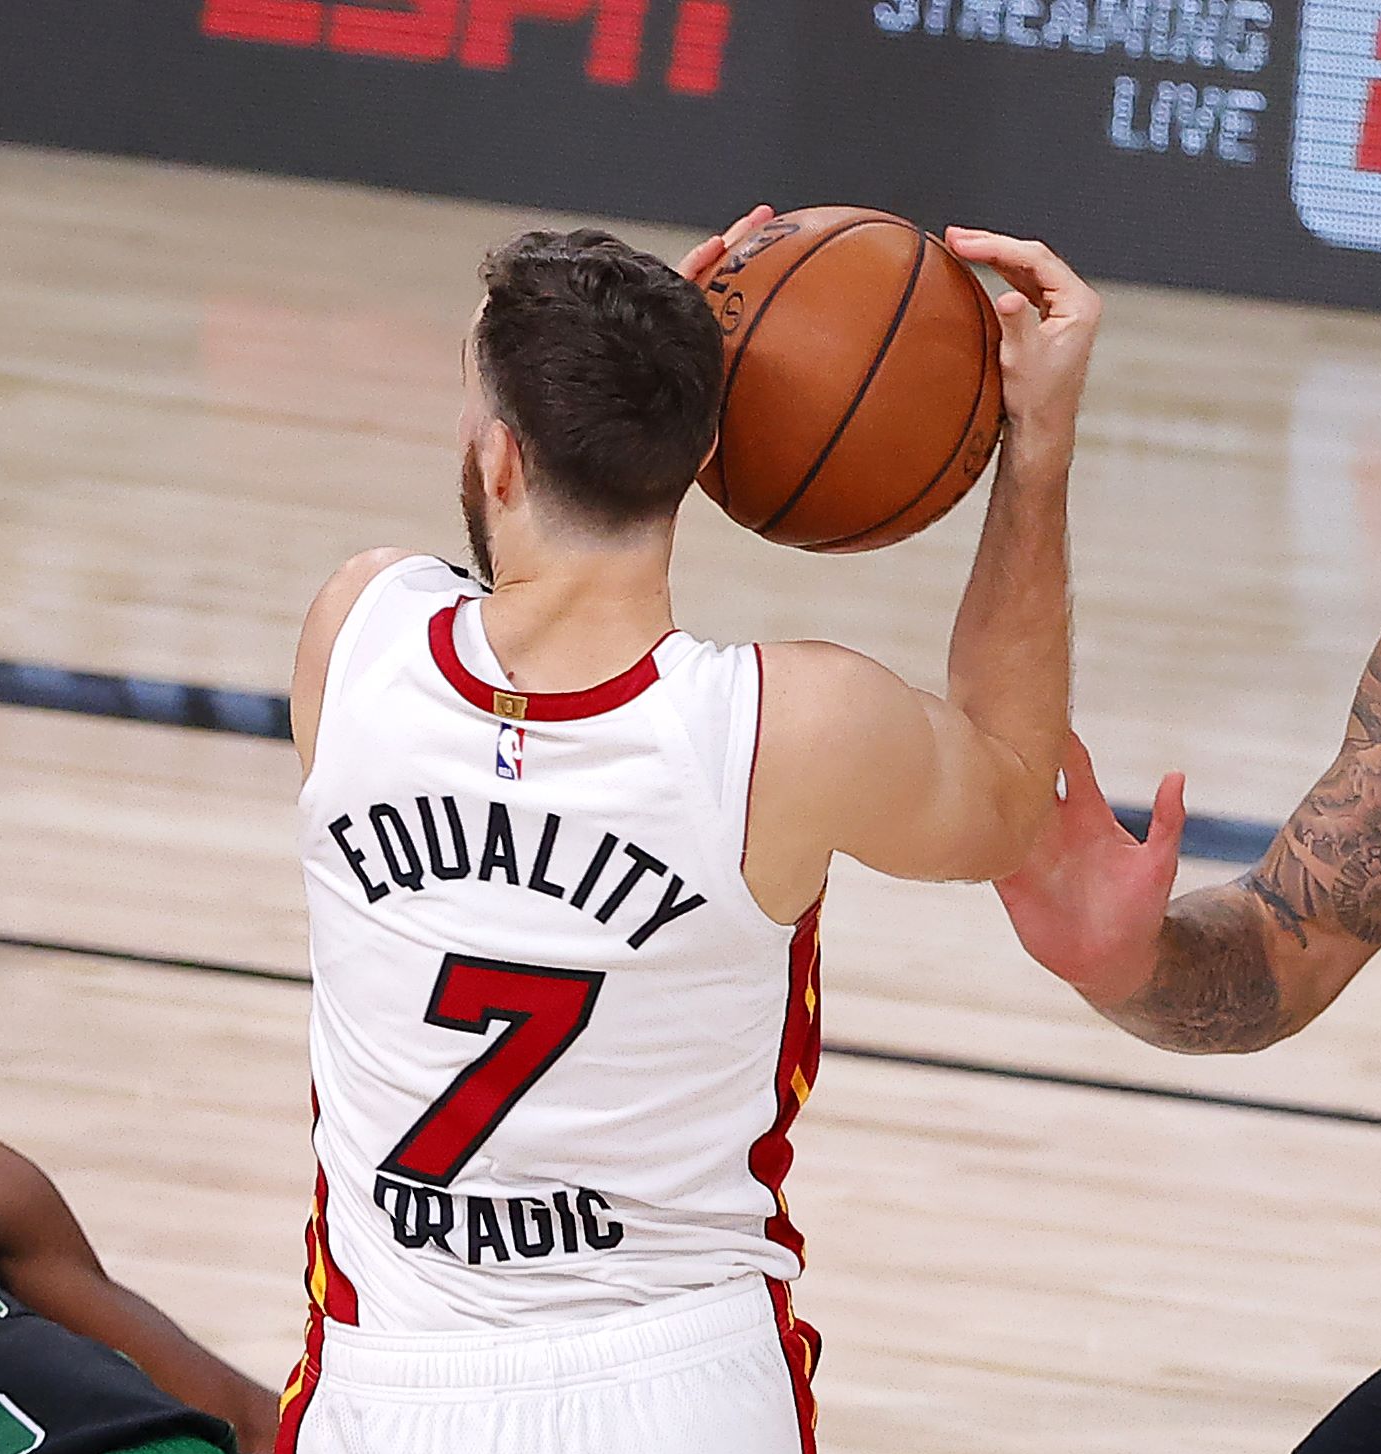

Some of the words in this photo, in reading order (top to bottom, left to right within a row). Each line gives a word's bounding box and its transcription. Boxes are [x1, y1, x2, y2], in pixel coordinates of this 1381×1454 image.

[1110, 75, 1268, 163] LIVE
[327, 795, 708, 951] EQUALITY
[376, 952, 607, 1188] 7
